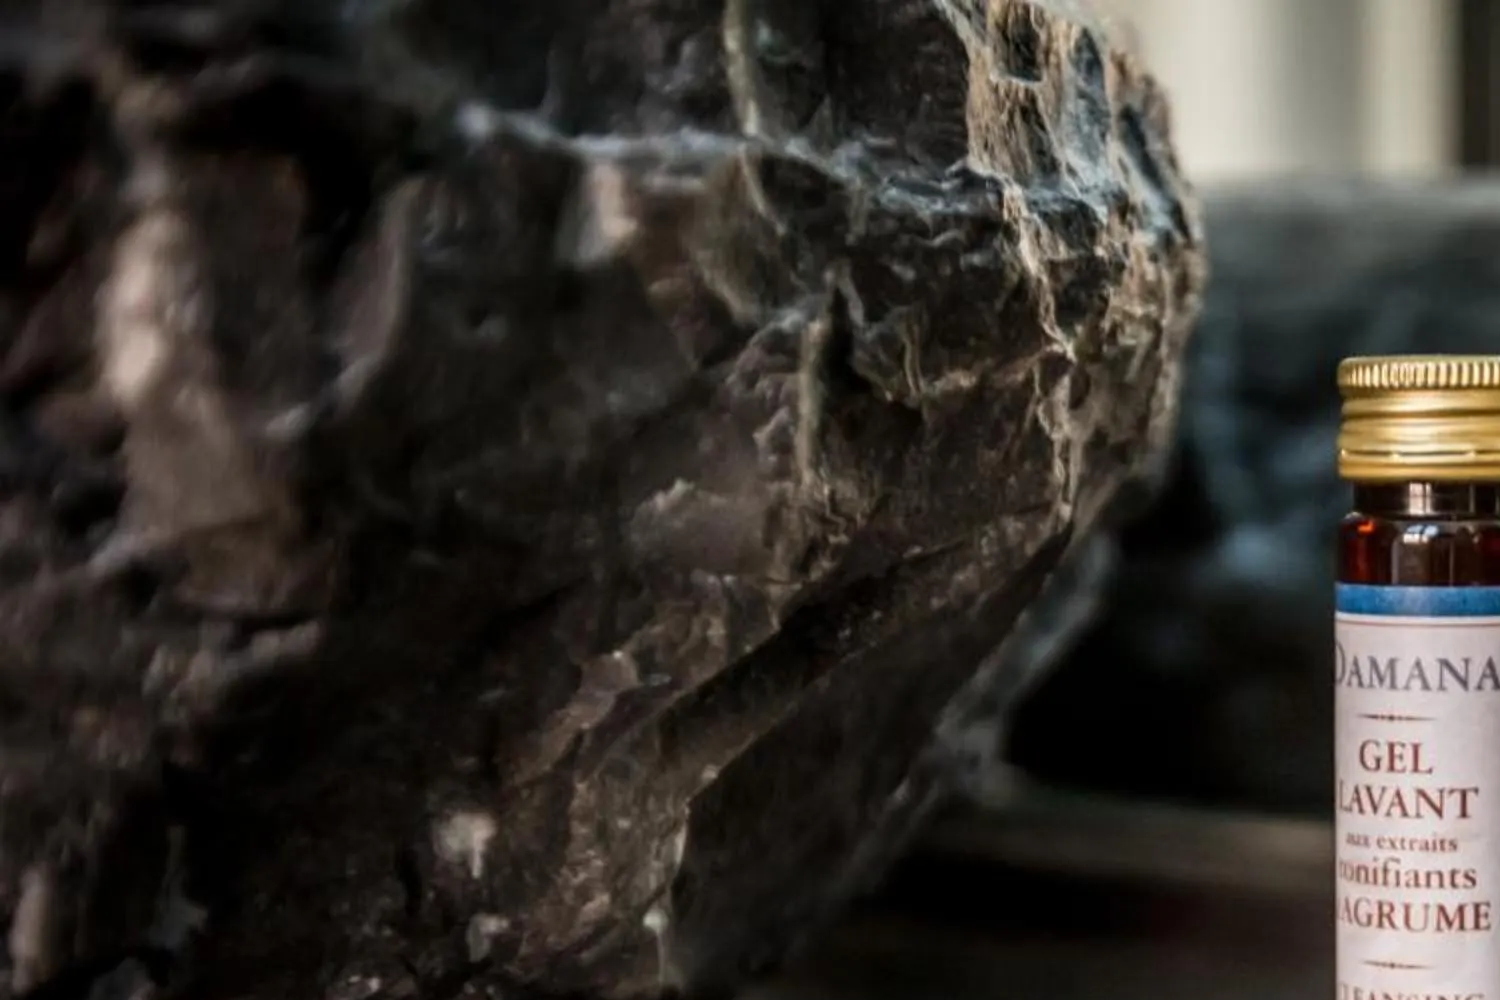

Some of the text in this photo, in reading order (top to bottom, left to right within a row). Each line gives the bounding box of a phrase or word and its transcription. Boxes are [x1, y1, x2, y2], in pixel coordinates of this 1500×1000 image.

[1358, 740, 1433, 775] GEL
[1338, 780, 1479, 820] LAVANT
[1377, 833, 1459, 852] extraits
